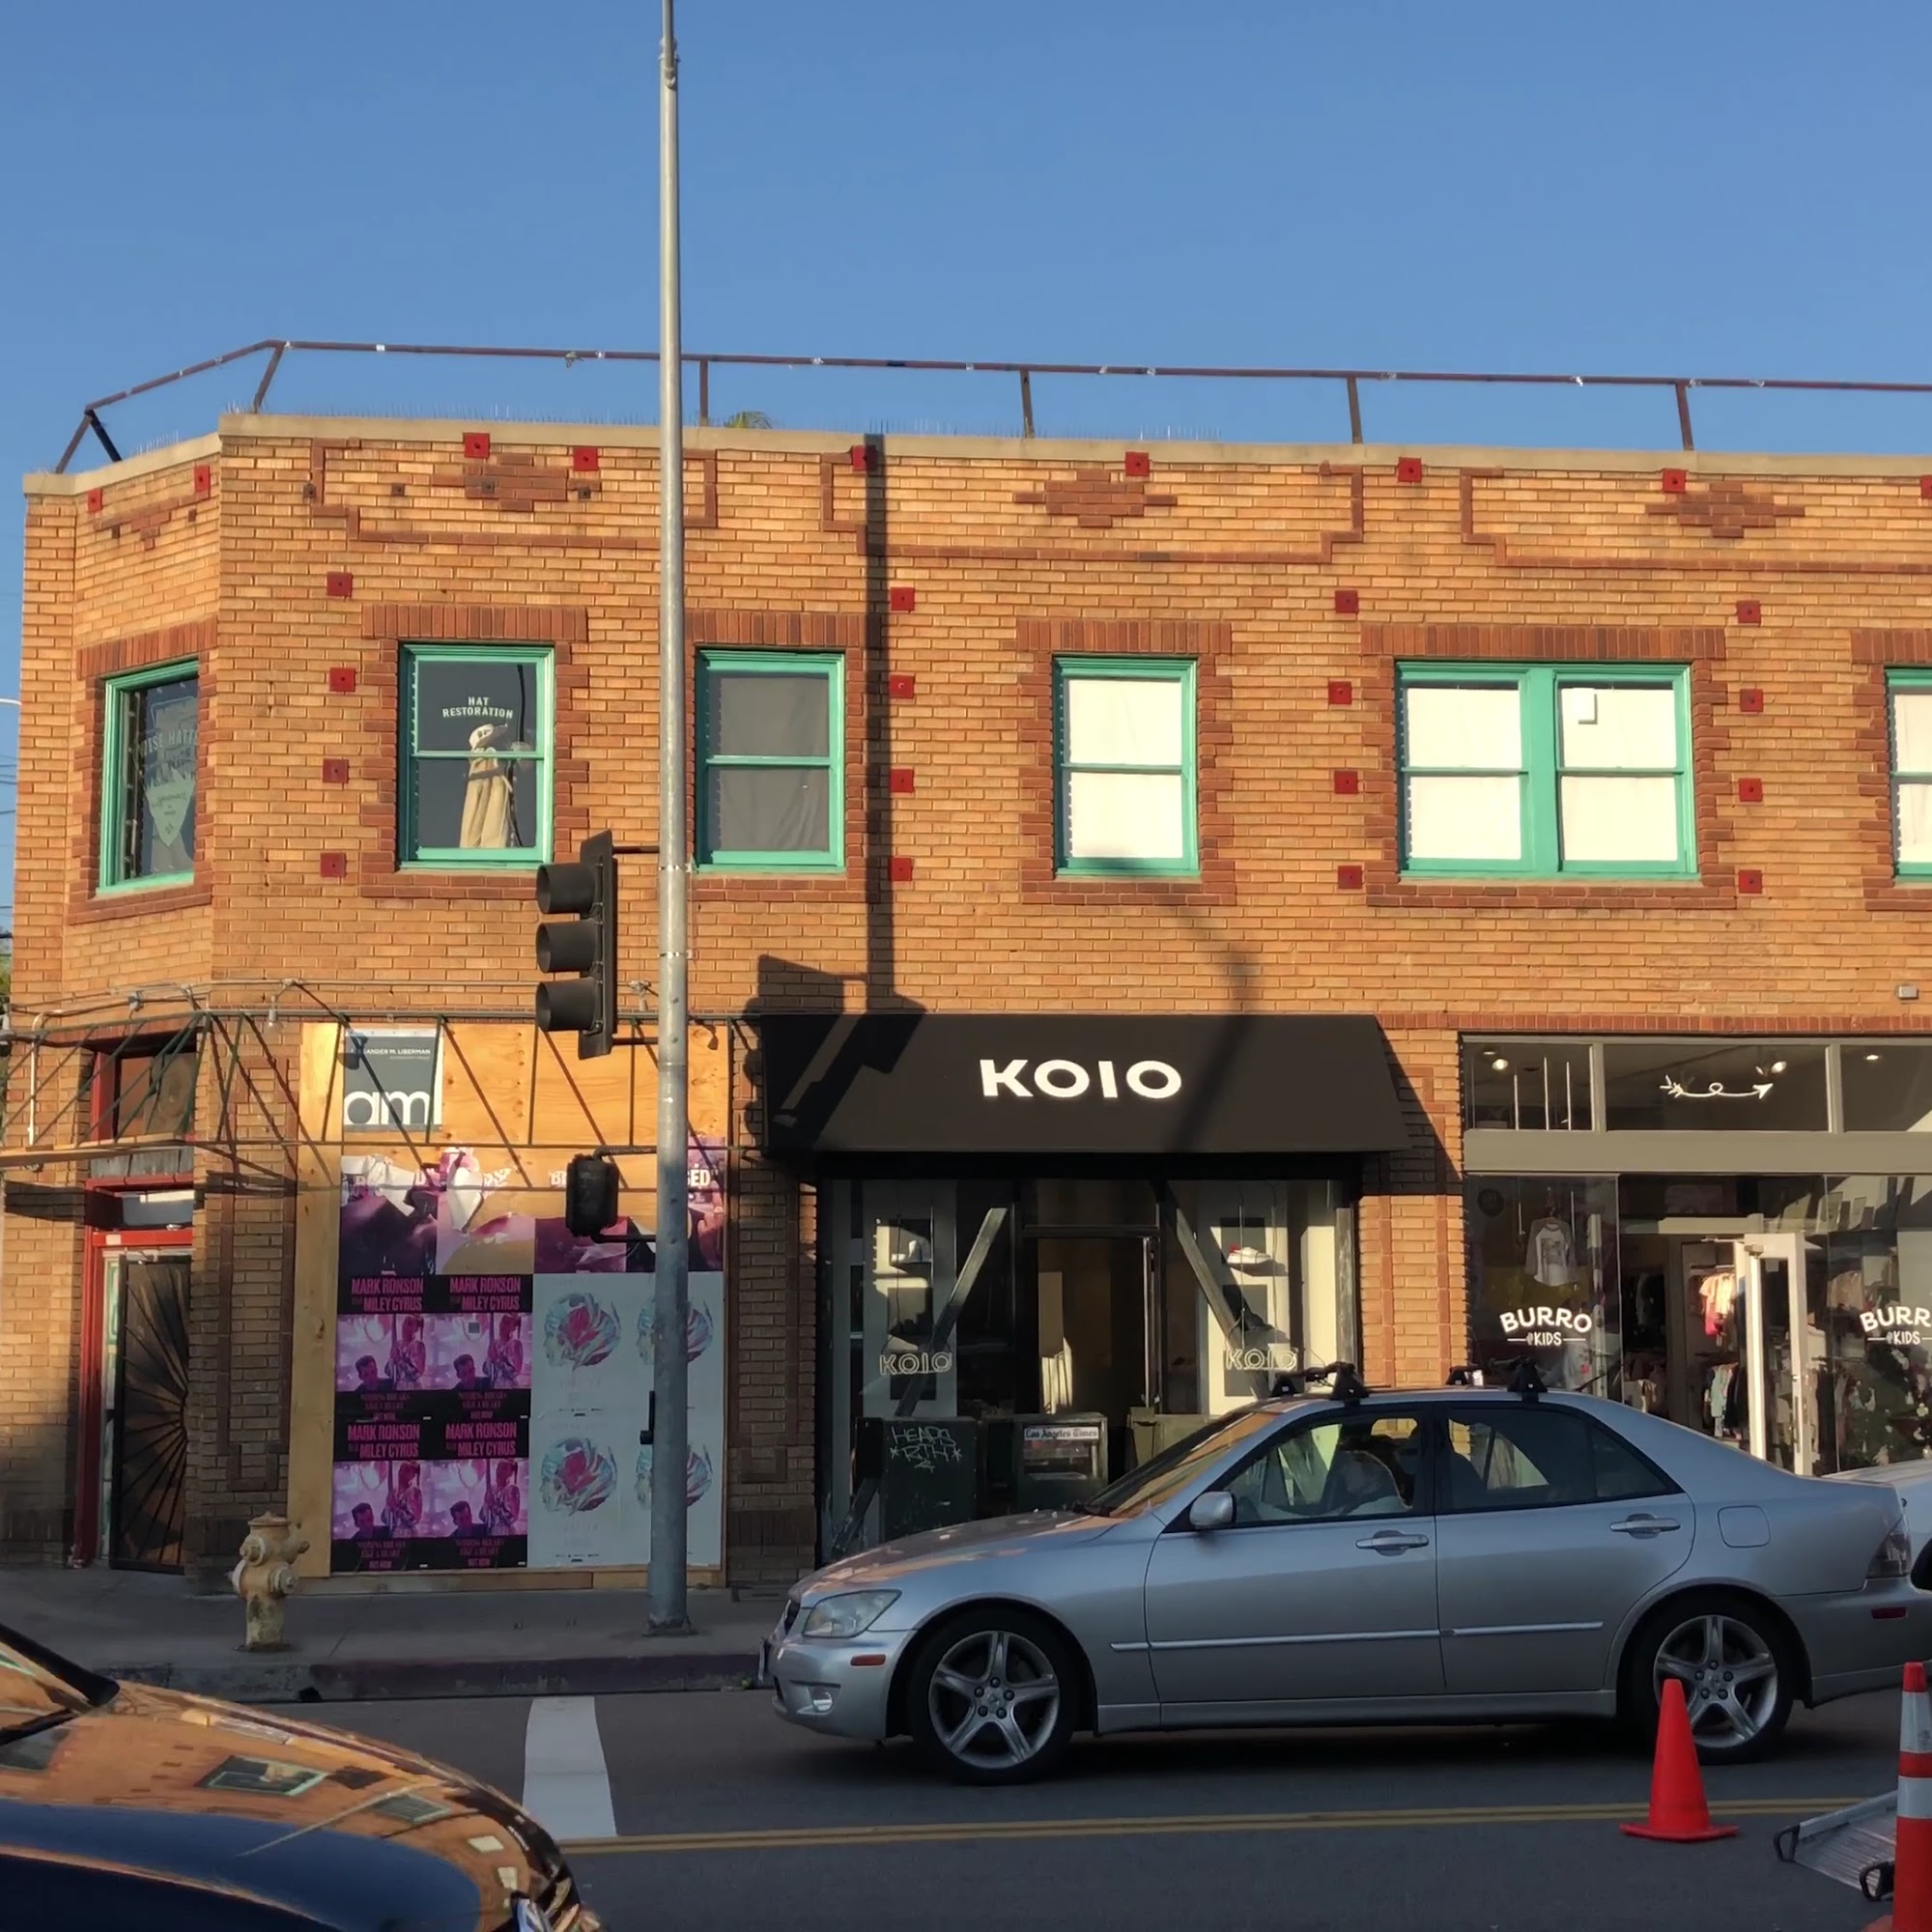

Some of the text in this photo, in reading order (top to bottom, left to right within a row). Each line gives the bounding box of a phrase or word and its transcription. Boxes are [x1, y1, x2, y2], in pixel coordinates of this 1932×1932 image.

[468, 696, 490, 706] HAT
[442, 706, 514, 719] RESTORATION
[980, 1059, 1182, 1099] KOIO
[352, 1278, 424, 1294] MARK RONSON
[450, 1276, 522, 1293] MARK RONSON
[363, 1296, 391, 1312] MILEY
[392, 1296, 422, 1311] CYRUS
[462, 1295, 489, 1311] MILEY
[490, 1295, 520, 1310] CYRUS
[1499, 1306, 1592, 1333] BURRO
[1860, 1306, 1932, 1332] BURR
[1534, 1331, 1562, 1347] KIDS
[1893, 1330, 1921, 1345] KIDS
[880, 1351, 952, 1376] KOIO
[1226, 1348, 1297, 1371] KOIO
[348, 1423, 420, 1440] MARK RONSON
[445, 1422, 518, 1439] MARK RONSON
[1026, 1428, 1039, 1438] Los
[359, 1443, 386, 1459] MILEY
[388, 1442, 419, 1458] CYRUS
[457, 1441, 485, 1457] MILEY
[486, 1440, 516, 1456] CYRUS
